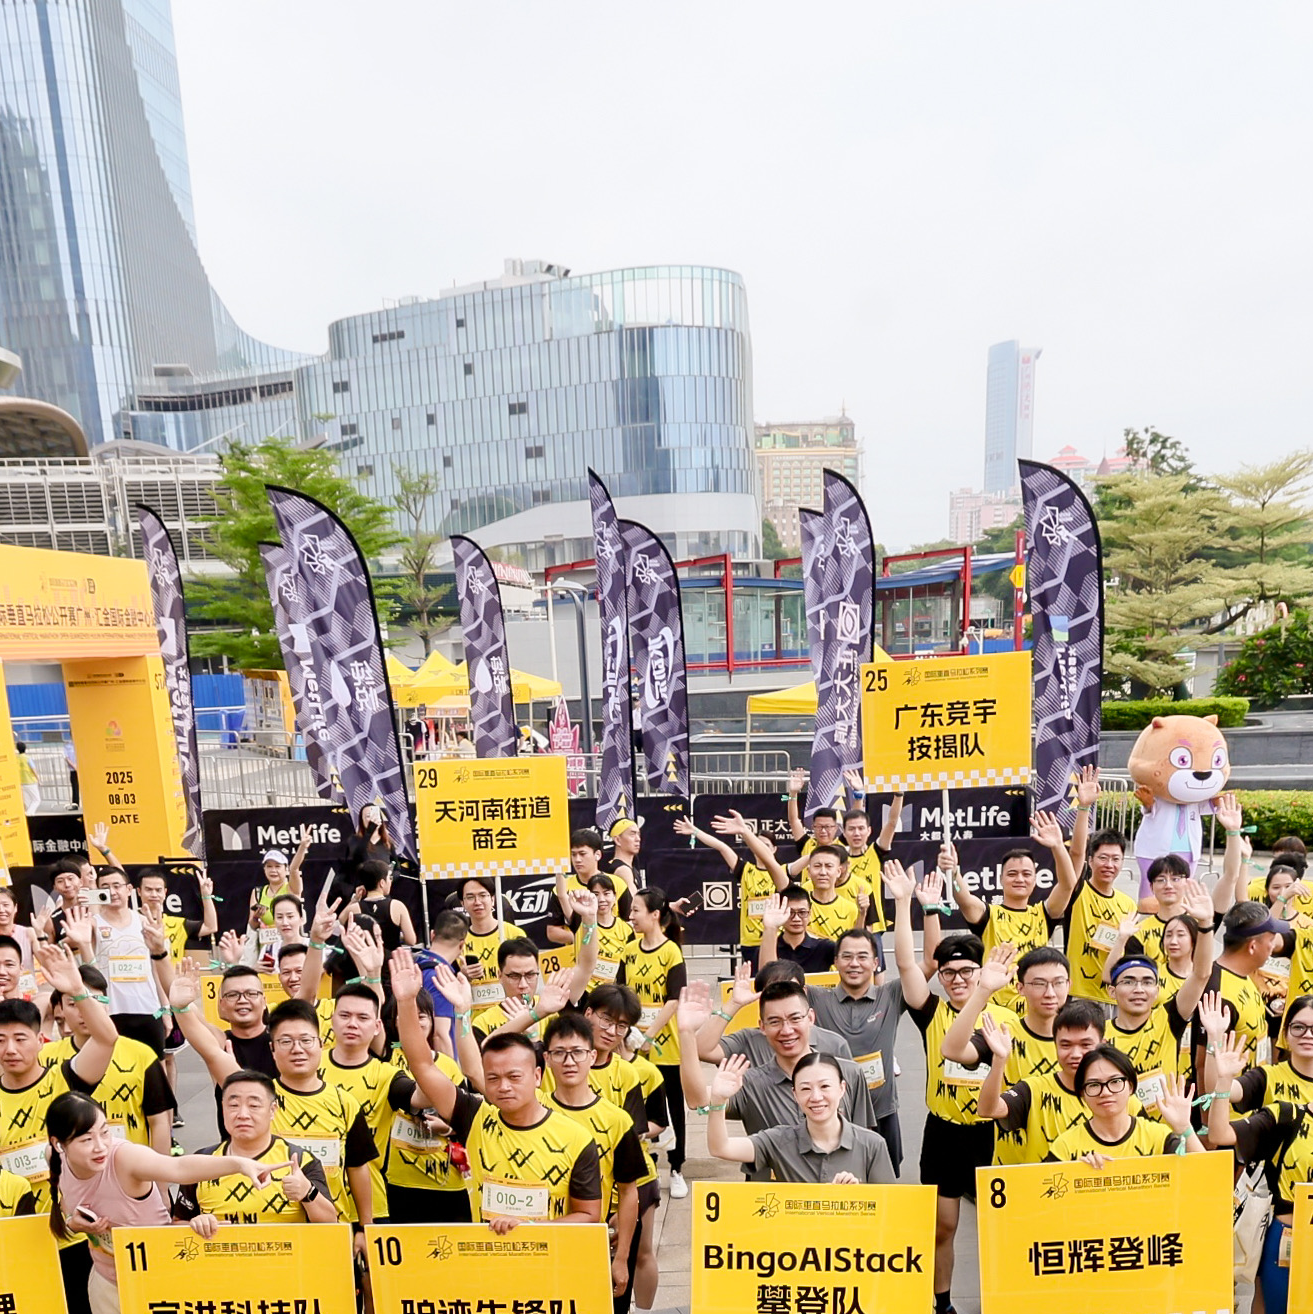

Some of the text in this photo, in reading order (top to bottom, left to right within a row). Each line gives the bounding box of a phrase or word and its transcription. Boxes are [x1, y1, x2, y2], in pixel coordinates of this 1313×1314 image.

[865, 669, 887, 692] 25
[894, 699, 997, 730] 广东竞宇
[908, 733, 985, 761] 按揭队
[106, 771, 133, 784] 2025
[418, 769, 438, 789] 29
[435, 796, 551, 823] 天河南街道
[920, 805, 1011, 828] MetLife
[111, 815, 140, 825] DATE
[472, 827, 518, 850] 商会
[920, 831, 973, 841] 大都人寿
[541, 956, 561, 974] 28
[595, 963, 614, 973] 29-3
[476, 988, 500, 998] 029-1
[1074, 1173, 1169, 1188] 国际垂直马拉松系列赛
[495, 1193, 534, 1207] 010-2
[990, 1177, 1006, 1209] 8
[705, 1191, 721, 1222] 9
[785, 1200, 876, 1210] 国际垂直马拉松系列赛
[125, 1241, 148, 1272] 11
[204, 1242, 292, 1252] 国际垂直马拉松系列赛
[373, 1236, 403, 1266] 10
[458, 1242, 548, 1251] 国际垂直马拉松系列赛
[1029, 1232, 1184, 1277] 恒辉登峰
